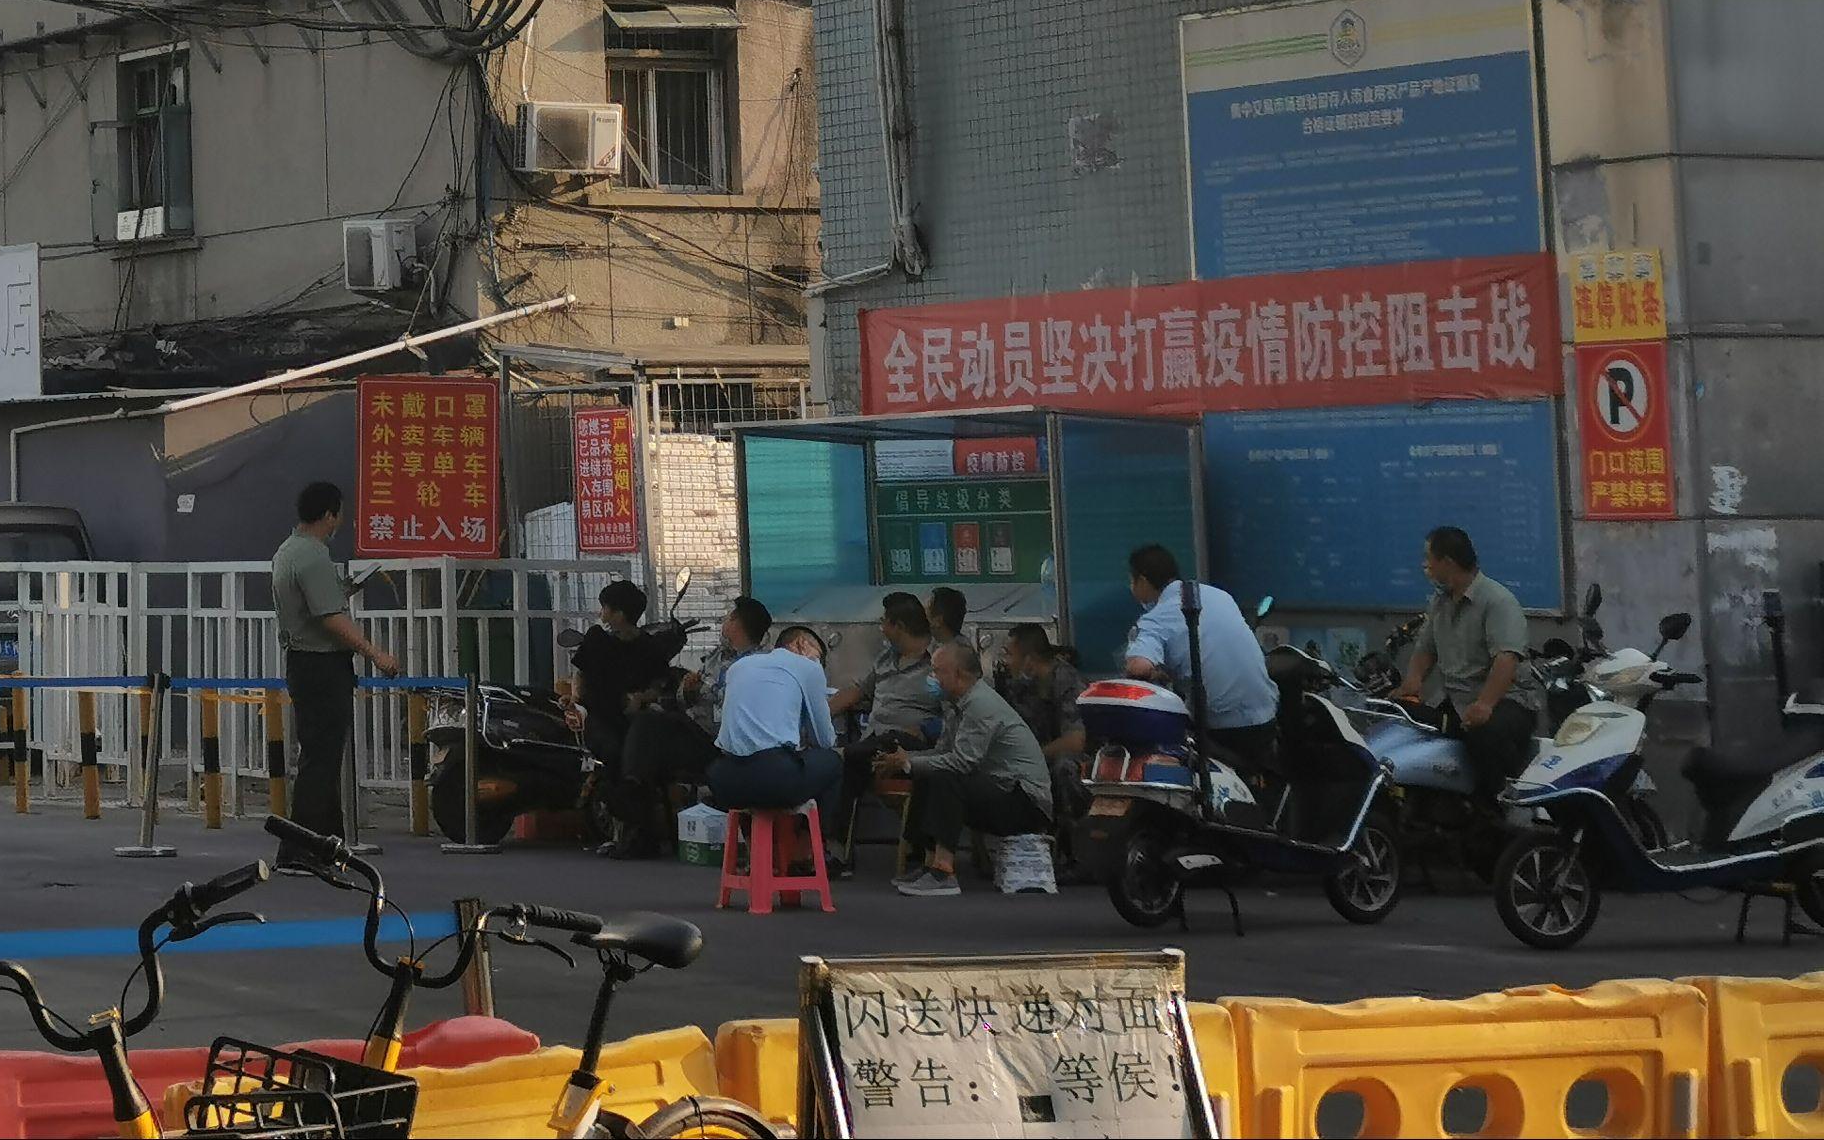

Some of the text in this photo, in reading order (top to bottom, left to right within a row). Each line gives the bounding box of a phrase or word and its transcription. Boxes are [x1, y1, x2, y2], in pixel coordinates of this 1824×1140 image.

[883, 281, 1536, 403] 全民动员坚决打赢疫情防控阻击战
[371, 391, 488, 420] 未戴口罩
[372, 423, 486, 447] 外卖车辆
[370, 450, 488, 478] 共享单车
[600, 418, 614, 519] 三米范围内
[613, 417, 630, 517] 严禁烟火
[1589, 447, 1666, 476] 门口范围
[370, 480, 488, 508] 三轮车
[896, 486, 1013, 511] 倡导垃圾分类
[1591, 480, 1667, 509] 严禁停车
[369, 513, 487, 543] 禁止入场
[843, 985, 1159, 1040] 闪送快递对面
